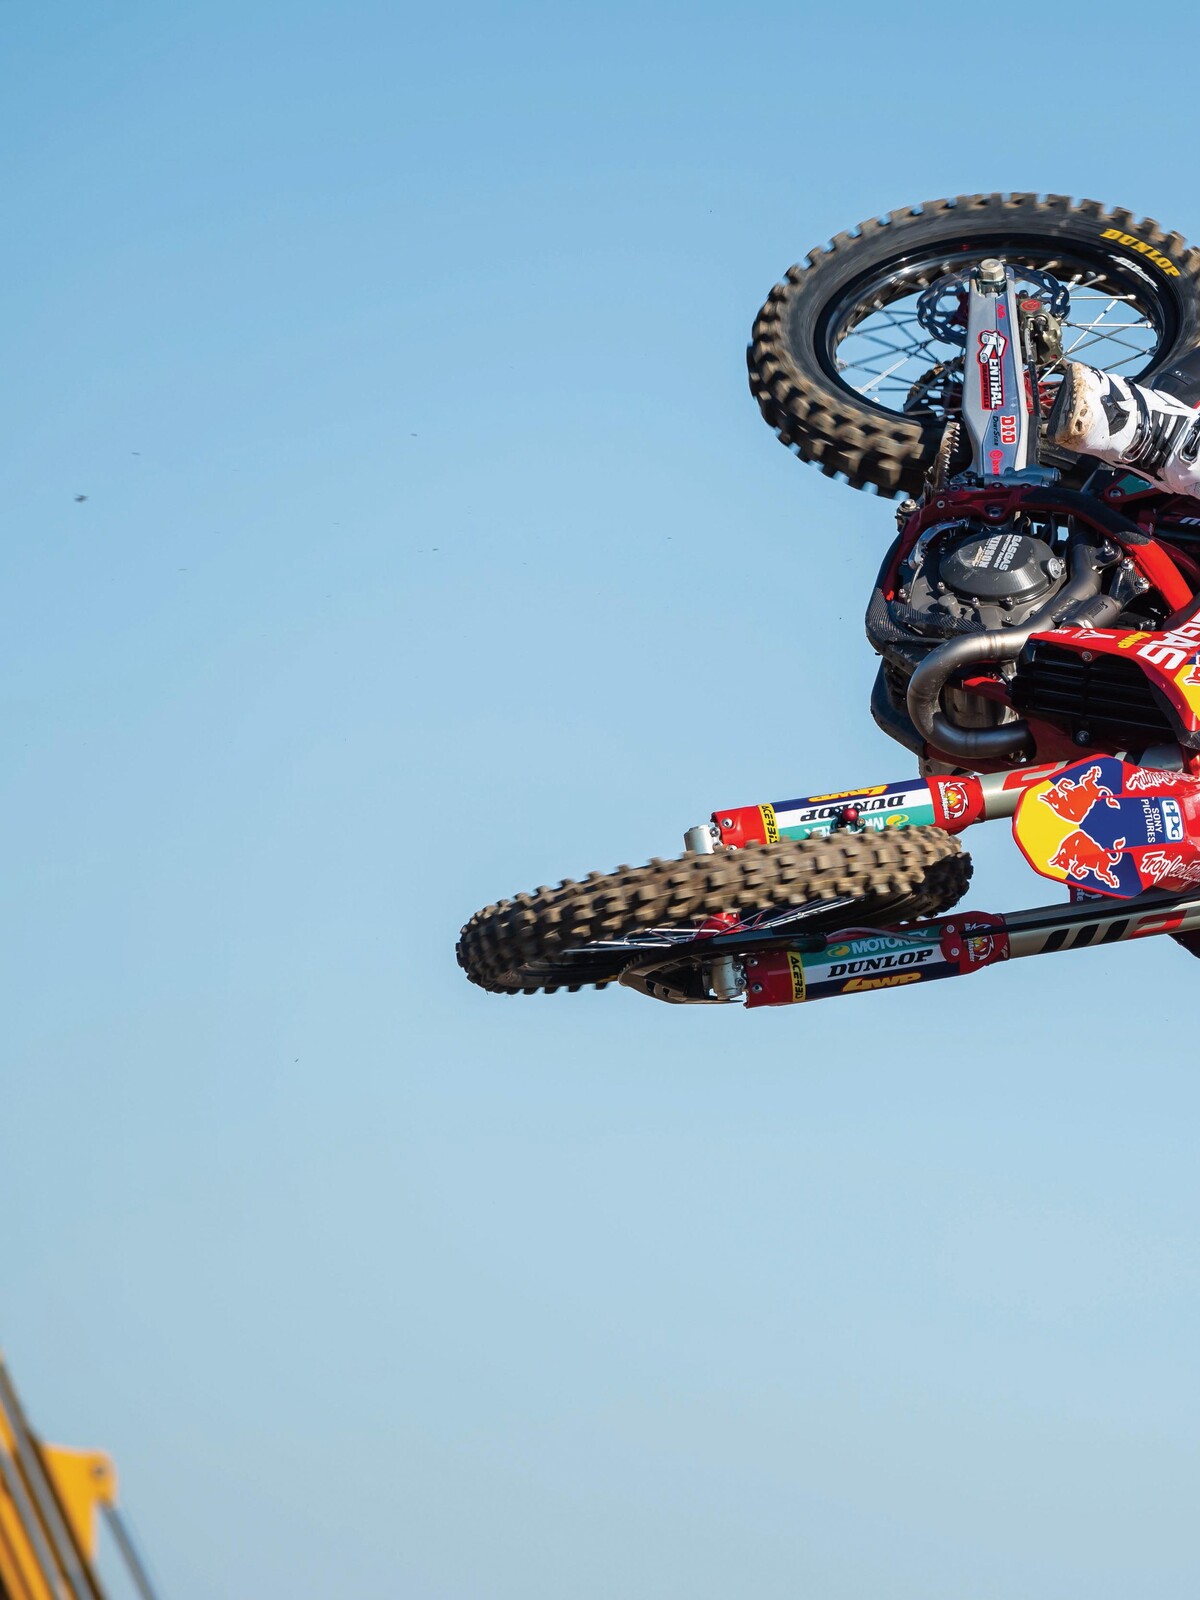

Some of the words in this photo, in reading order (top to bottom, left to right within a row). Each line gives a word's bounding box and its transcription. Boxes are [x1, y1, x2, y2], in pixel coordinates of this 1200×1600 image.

[1100, 228, 1180, 277] DUNLOP
[999, 534, 1023, 571] GASGAS
[1140, 799, 1156, 844] PICTURES
[1151, 807, 1163, 833] SONY
[827, 948, 934, 978] DUNLOP
